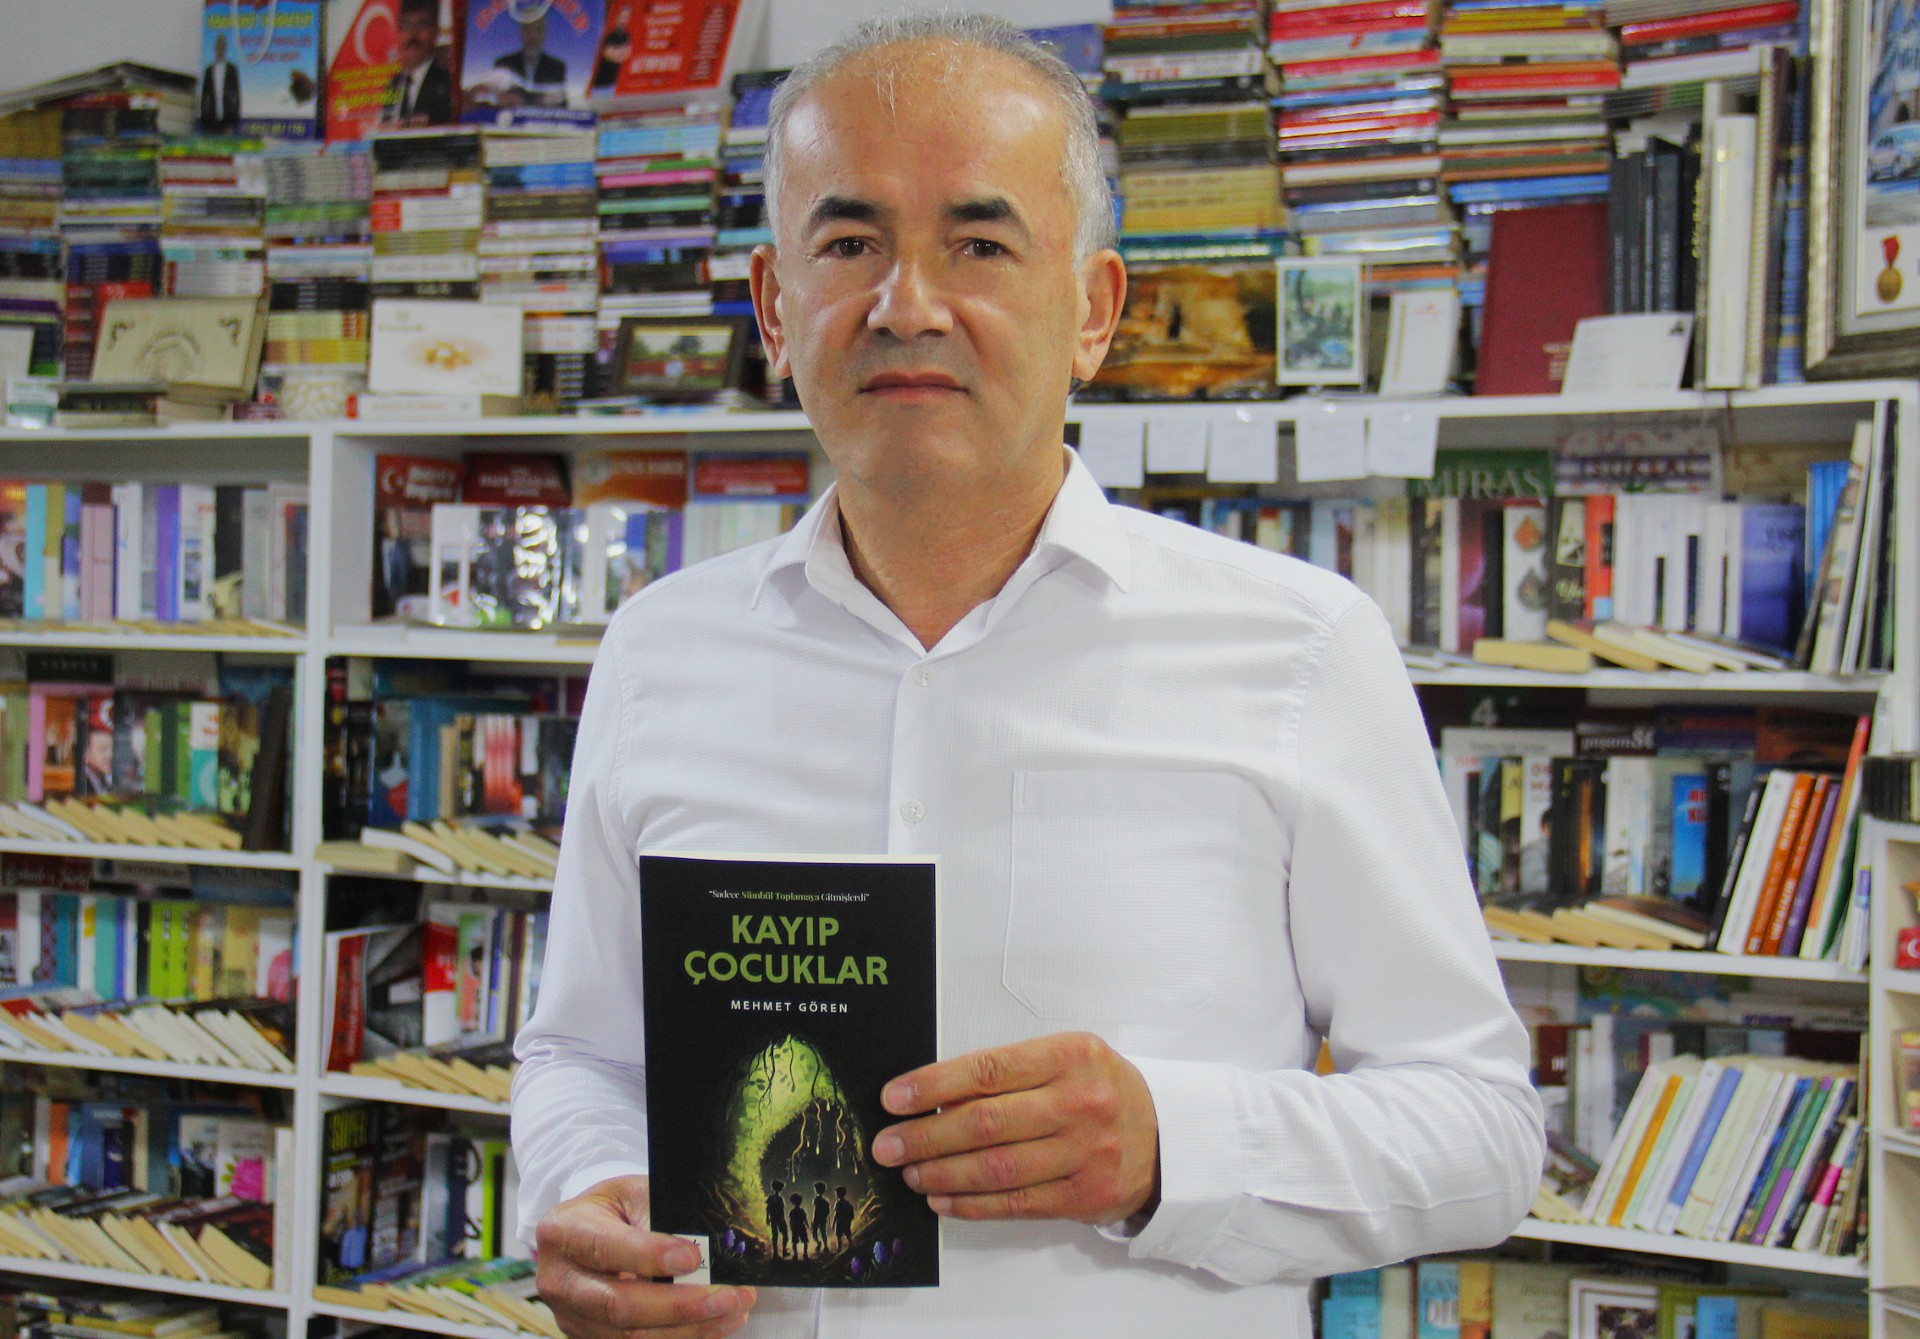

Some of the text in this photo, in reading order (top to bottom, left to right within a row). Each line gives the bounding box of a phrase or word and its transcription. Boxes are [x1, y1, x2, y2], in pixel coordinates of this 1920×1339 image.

[741, 890, 773, 900] Sümbül
[774, 891, 820, 903] Toplamaya
[731, 914, 840, 946] KAYIP
[684, 950, 889, 985] ÇOCUKLAR
[730, 1000, 848, 1014] MEHMET GÖREN
